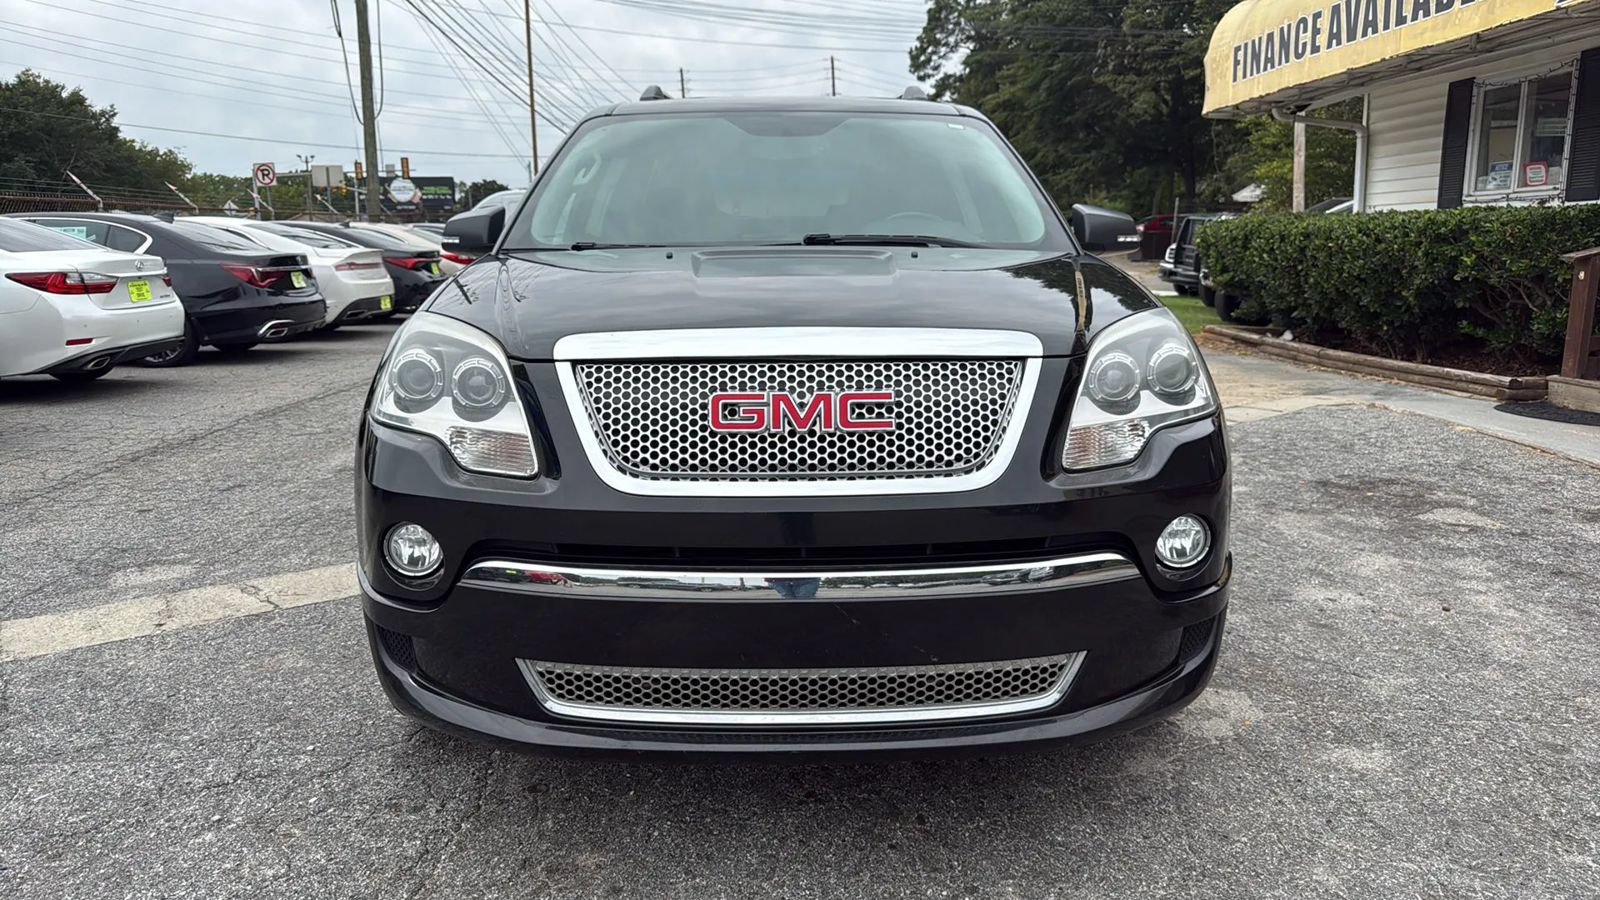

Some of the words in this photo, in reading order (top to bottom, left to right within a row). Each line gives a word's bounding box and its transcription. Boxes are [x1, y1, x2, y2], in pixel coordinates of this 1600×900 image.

[1232, 10, 1322, 83] FINANCE
[1326, 0, 1477, 50] AVAIL
[709, 391, 896, 433] GMC
